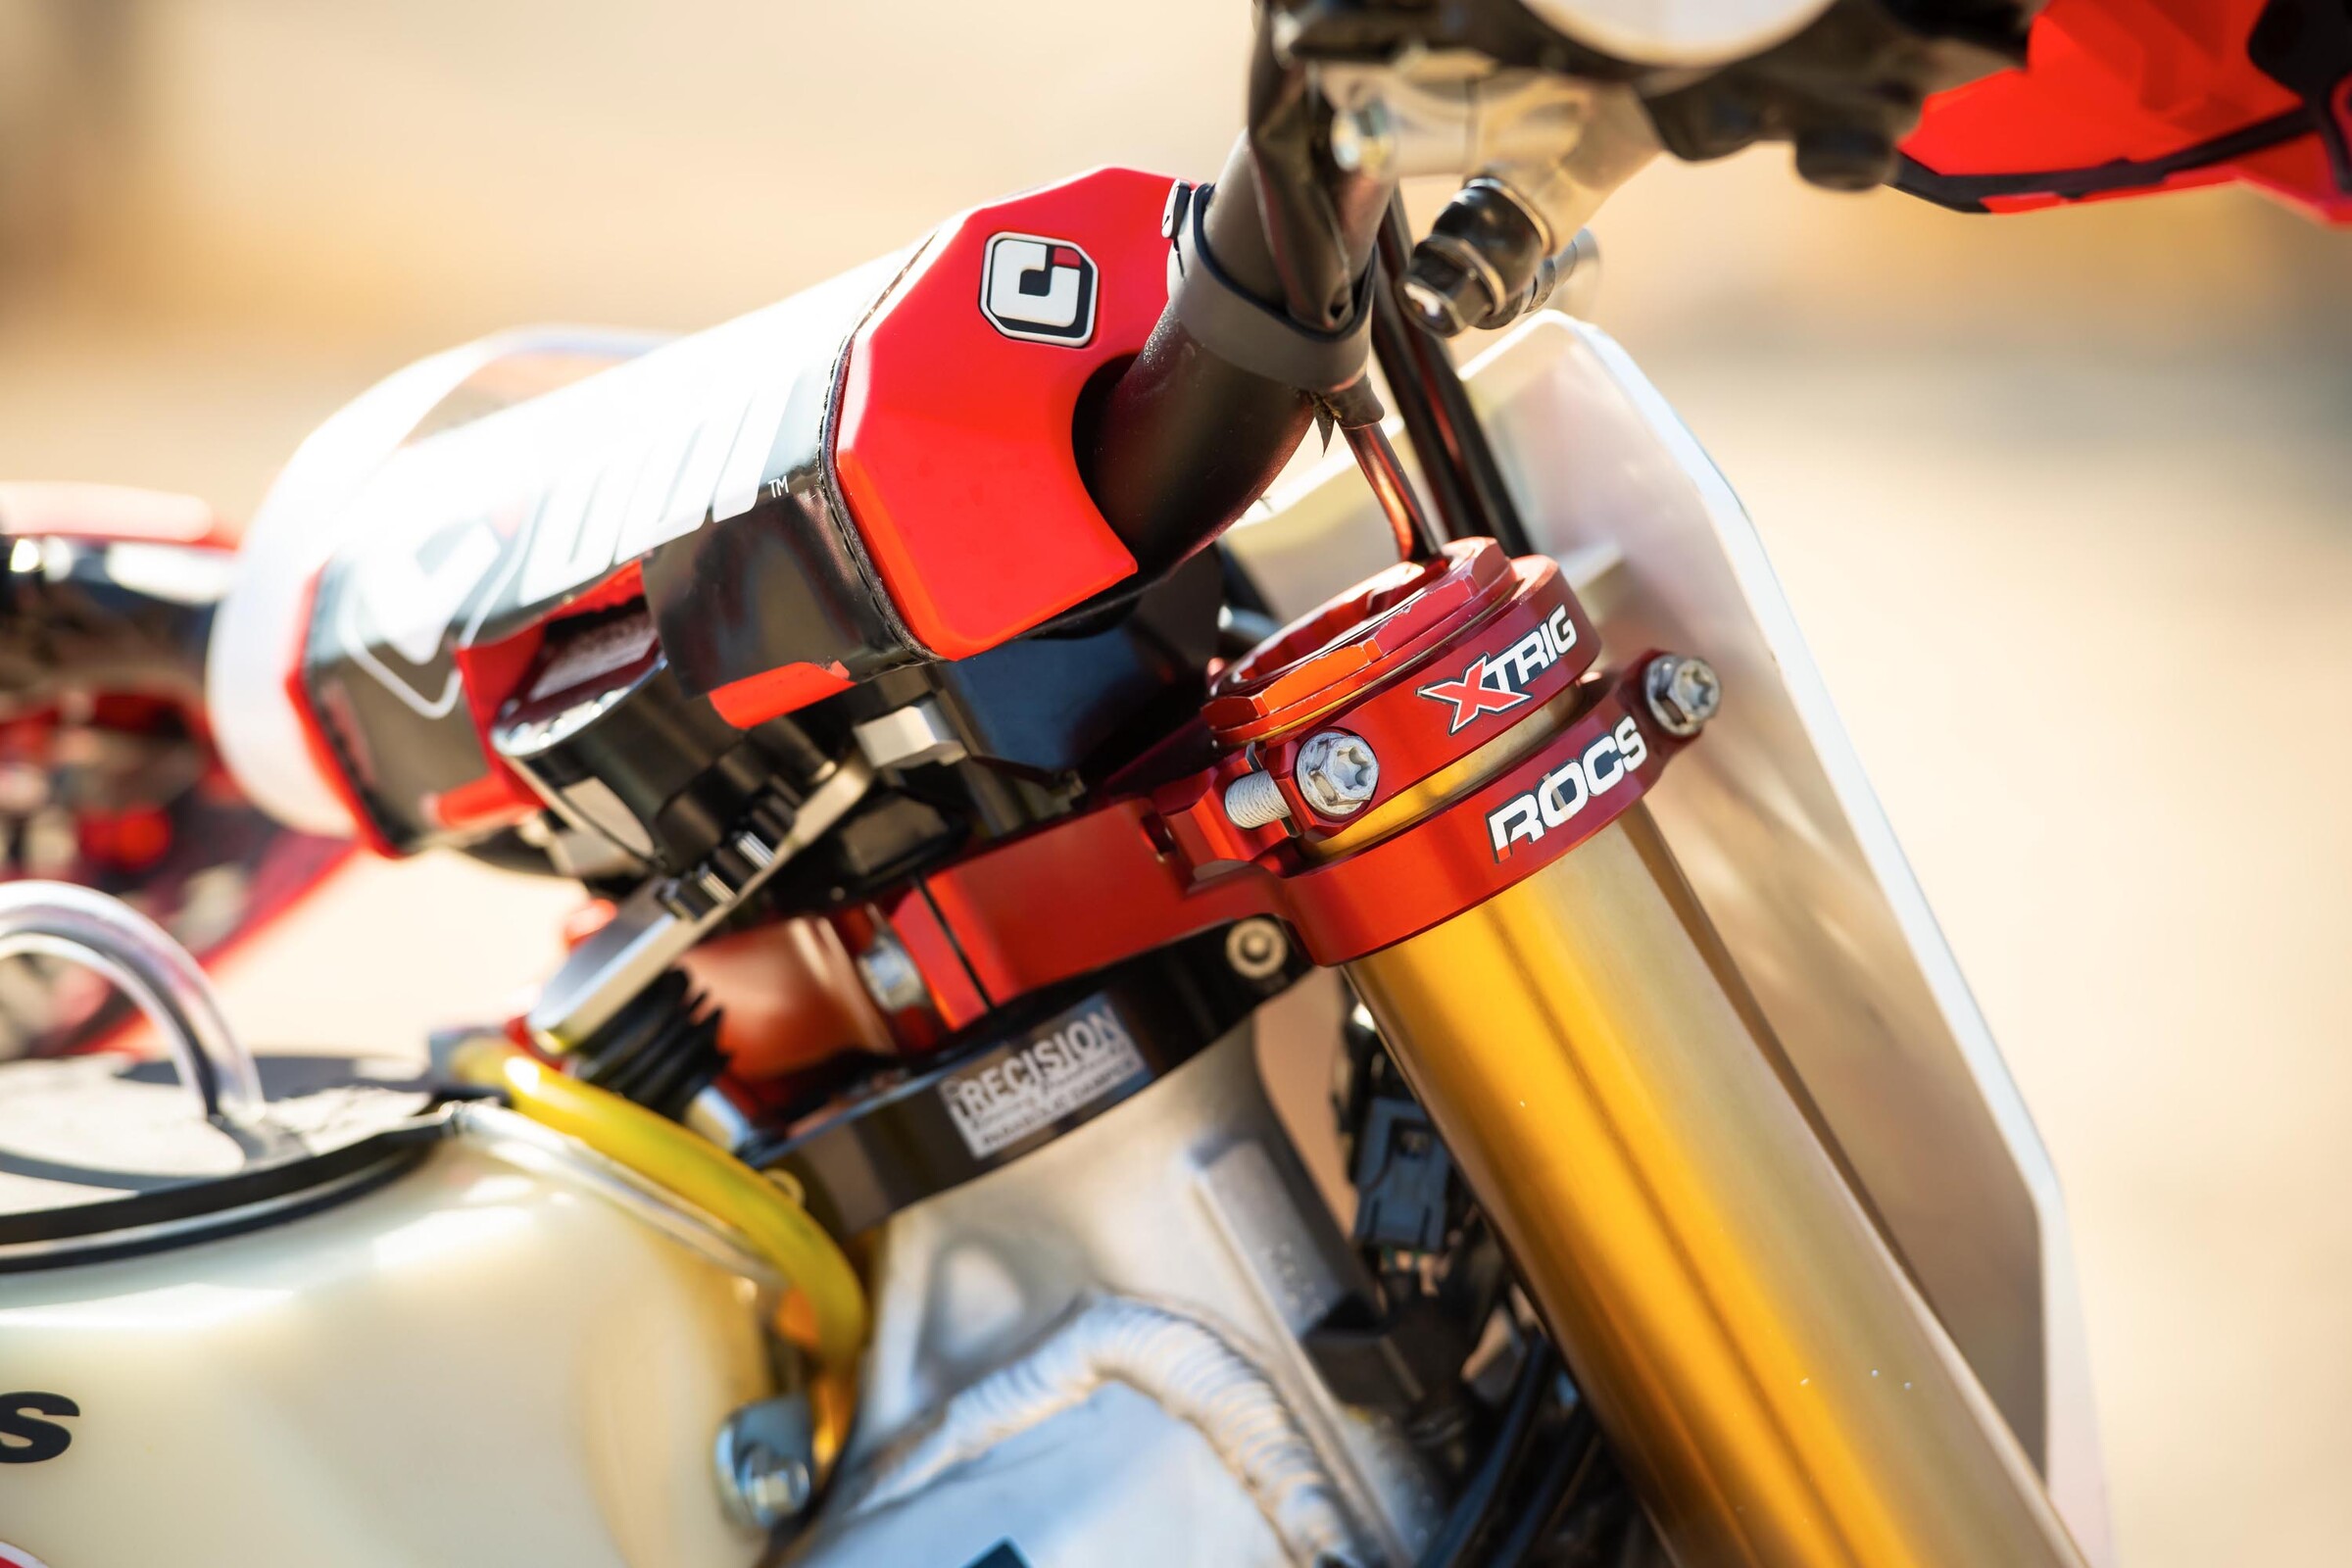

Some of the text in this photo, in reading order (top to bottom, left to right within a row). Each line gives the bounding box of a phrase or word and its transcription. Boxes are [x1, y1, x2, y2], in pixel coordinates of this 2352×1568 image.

[767, 475, 789, 498] TM
[1416, 603, 1579, 737] XTRIG
[1485, 714, 1648, 864] ROCS
